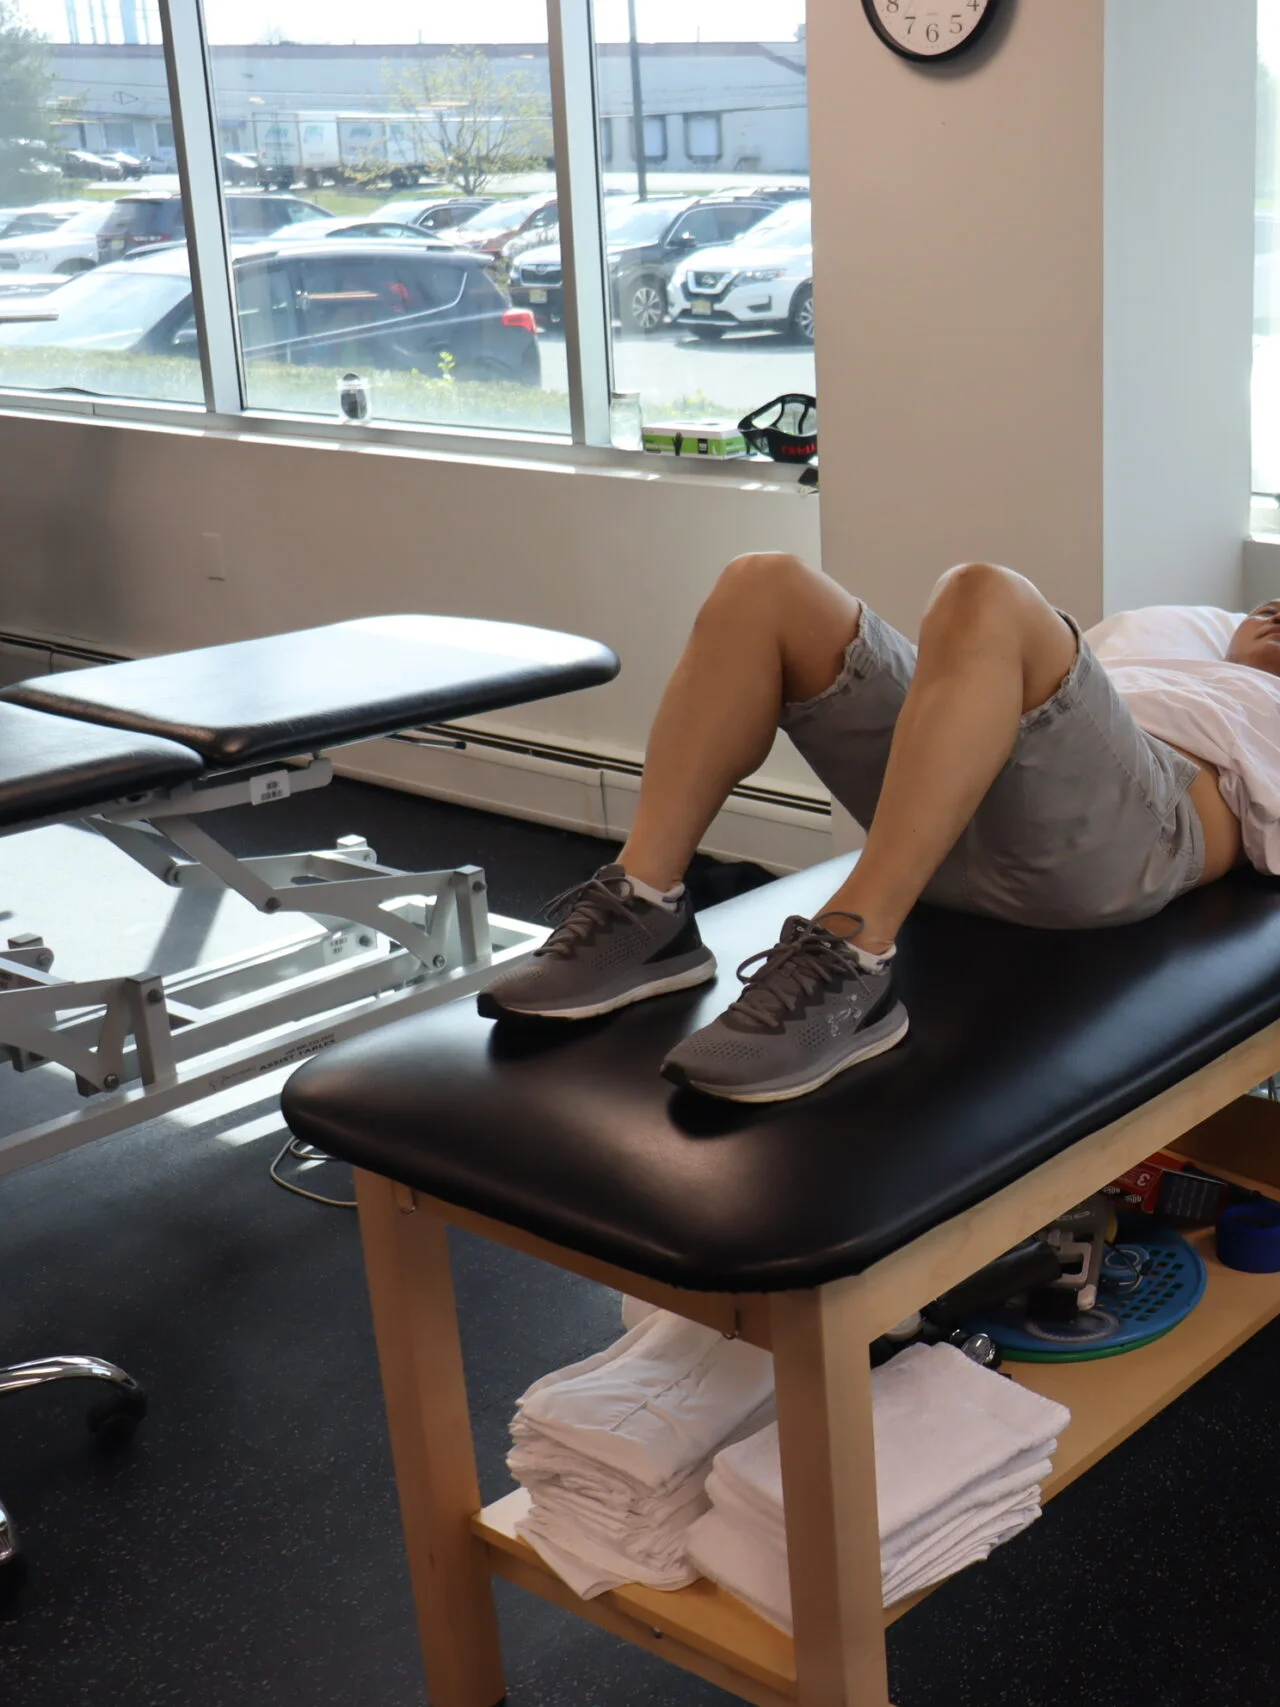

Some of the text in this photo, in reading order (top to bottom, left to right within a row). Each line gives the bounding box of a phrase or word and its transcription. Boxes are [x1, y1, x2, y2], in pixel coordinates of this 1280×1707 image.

[886, 0, 899, 13] 8
[904, 16, 916, 35] 7
[925, 23, 939, 43] 6
[949, 14, 963, 34] 5
